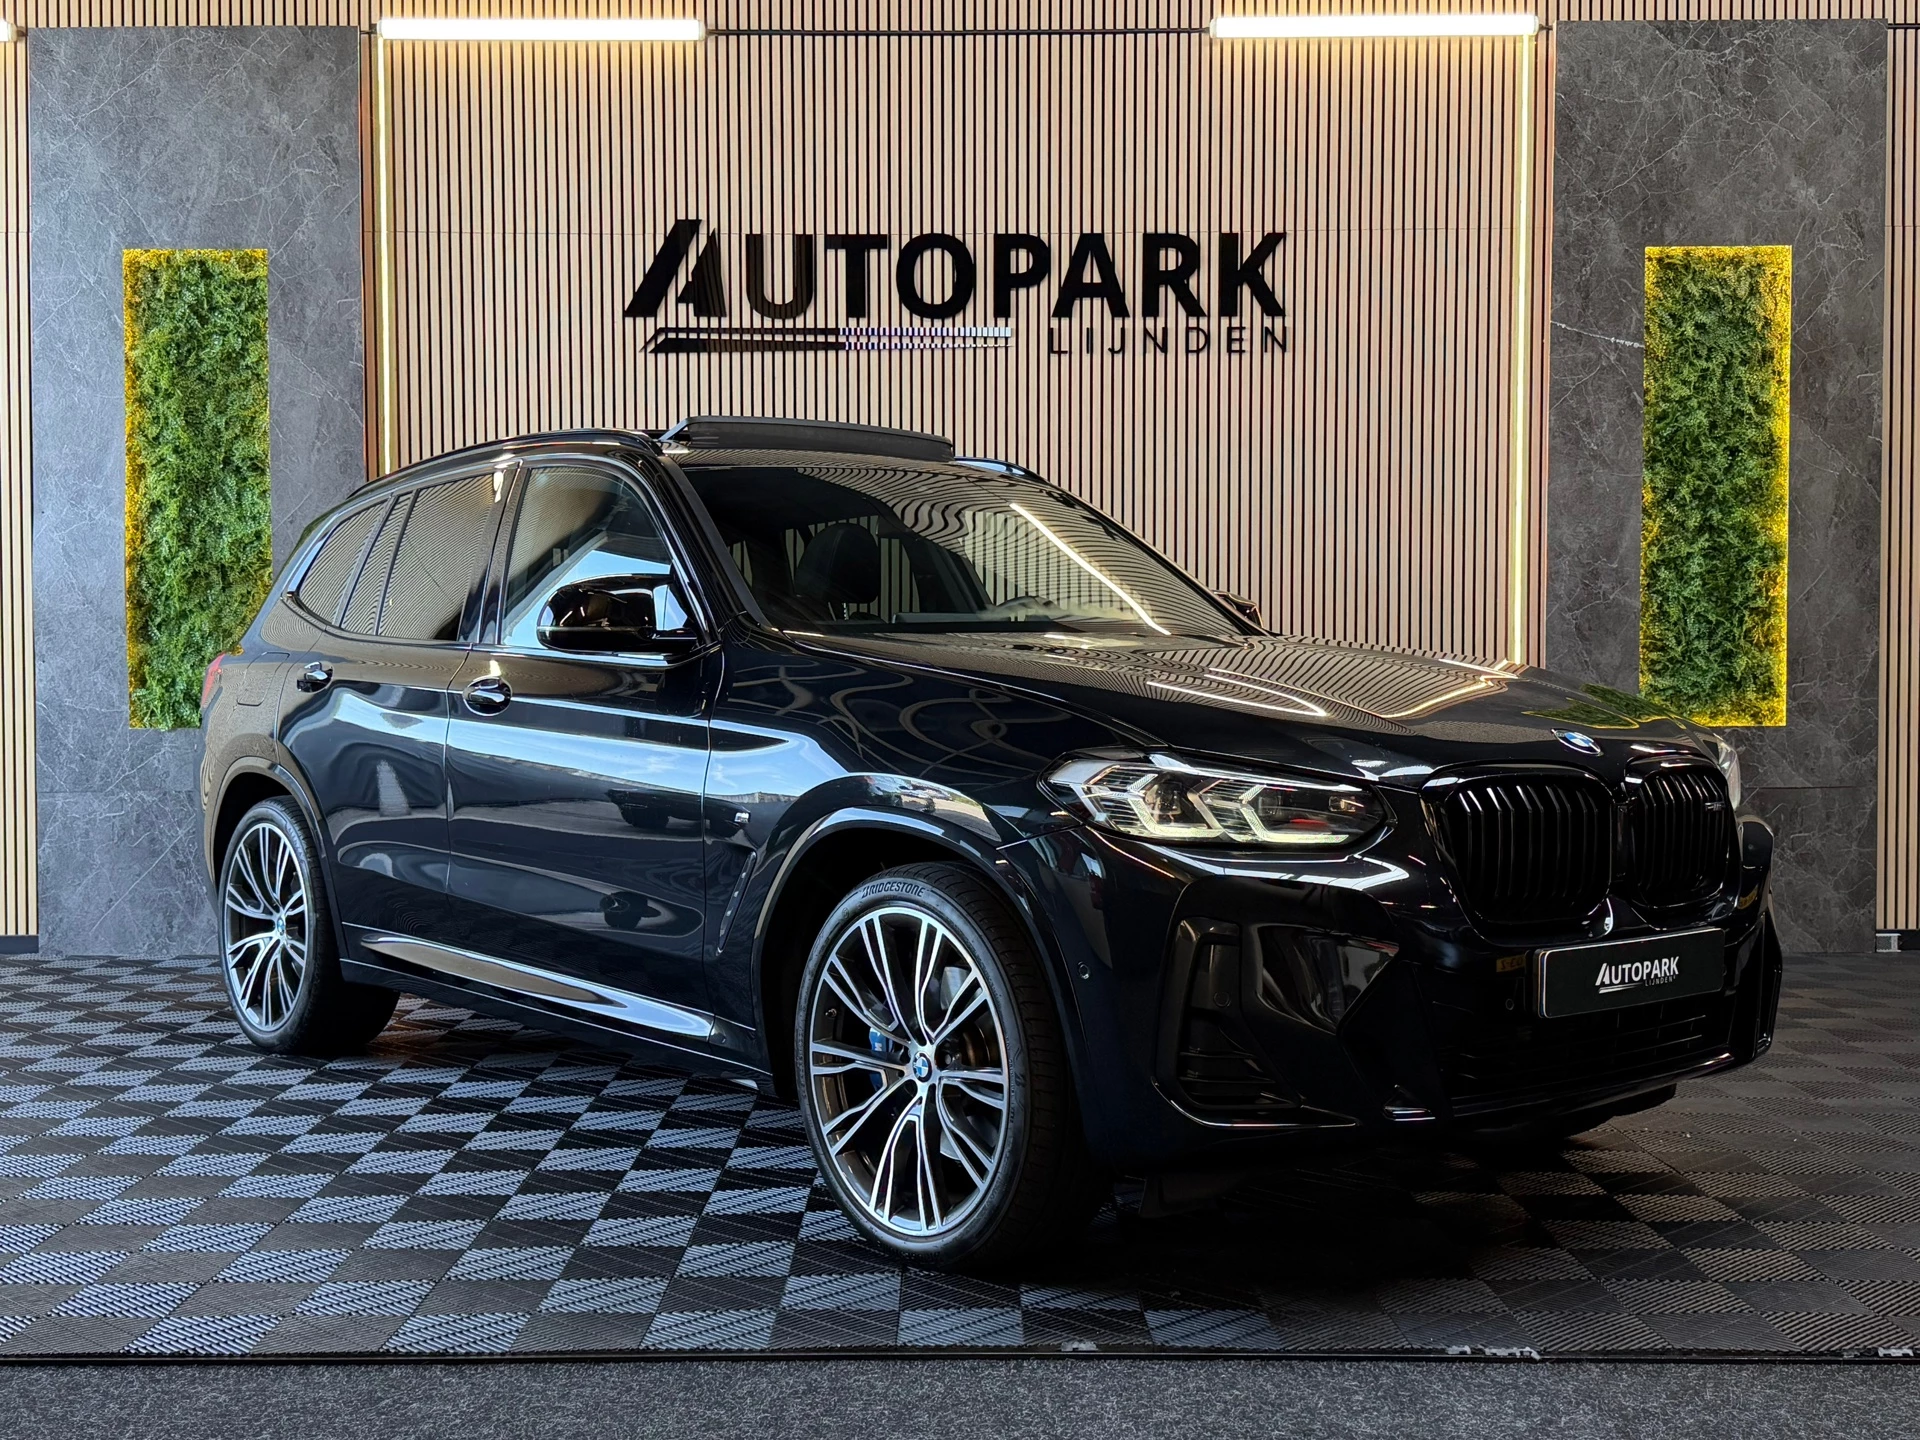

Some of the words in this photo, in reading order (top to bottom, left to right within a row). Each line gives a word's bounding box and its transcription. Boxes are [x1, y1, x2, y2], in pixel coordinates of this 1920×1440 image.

[623, 219, 1287, 319] AUTOPARK
[1049, 325, 1287, 355] LIJNDEN
[861, 881, 926, 899] BRIDGESTONE
[1595, 956, 1680, 986] AUTOPARK
[1644, 975, 1673, 987] LIJNDEN
